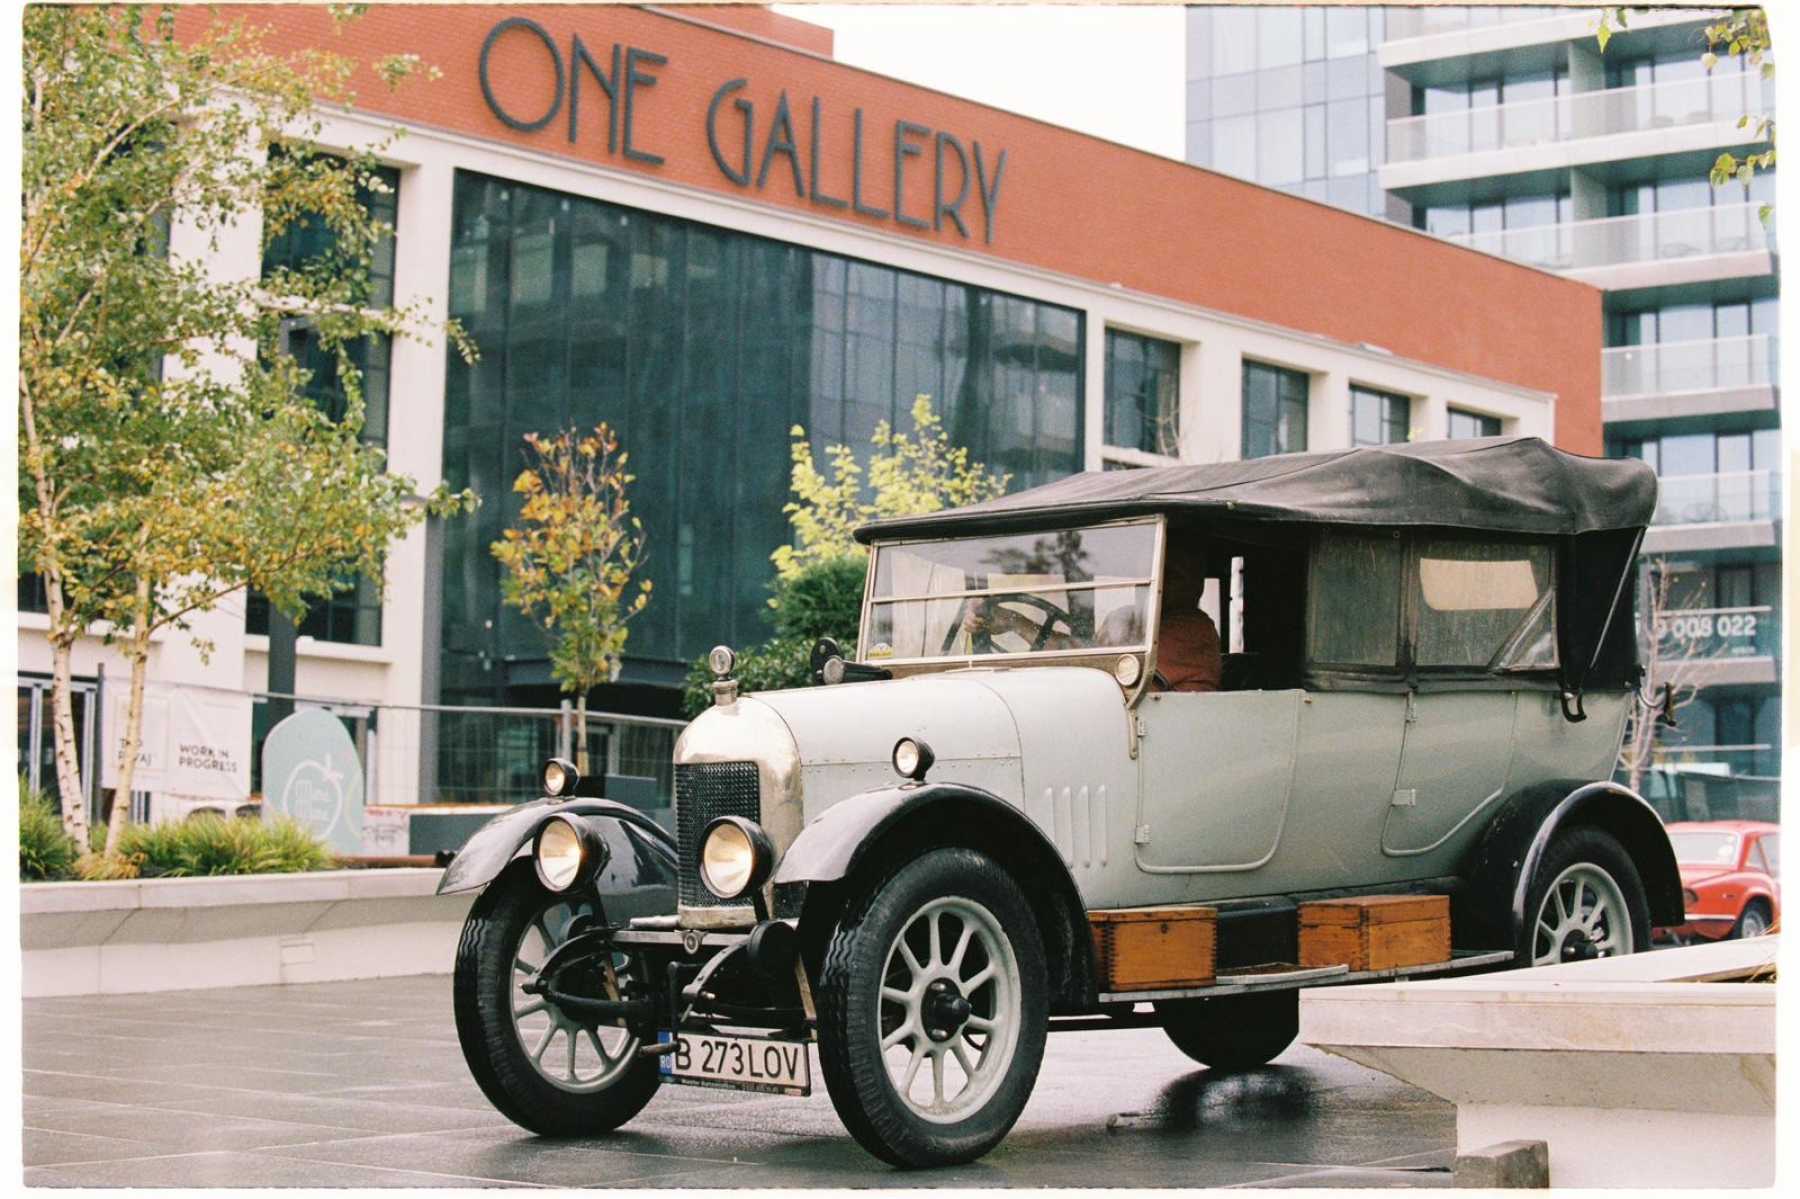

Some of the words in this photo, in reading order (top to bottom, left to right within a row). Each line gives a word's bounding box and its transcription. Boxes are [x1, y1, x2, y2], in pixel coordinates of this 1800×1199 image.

[479, 16, 668, 165] ONE
[706, 78, 1008, 245] GALLERY
[1717, 614, 1757, 637] 022
[180, 743, 214, 757] WORK
[178, 756, 238, 773] PROGRESS
[675, 1037, 692, 1070] B
